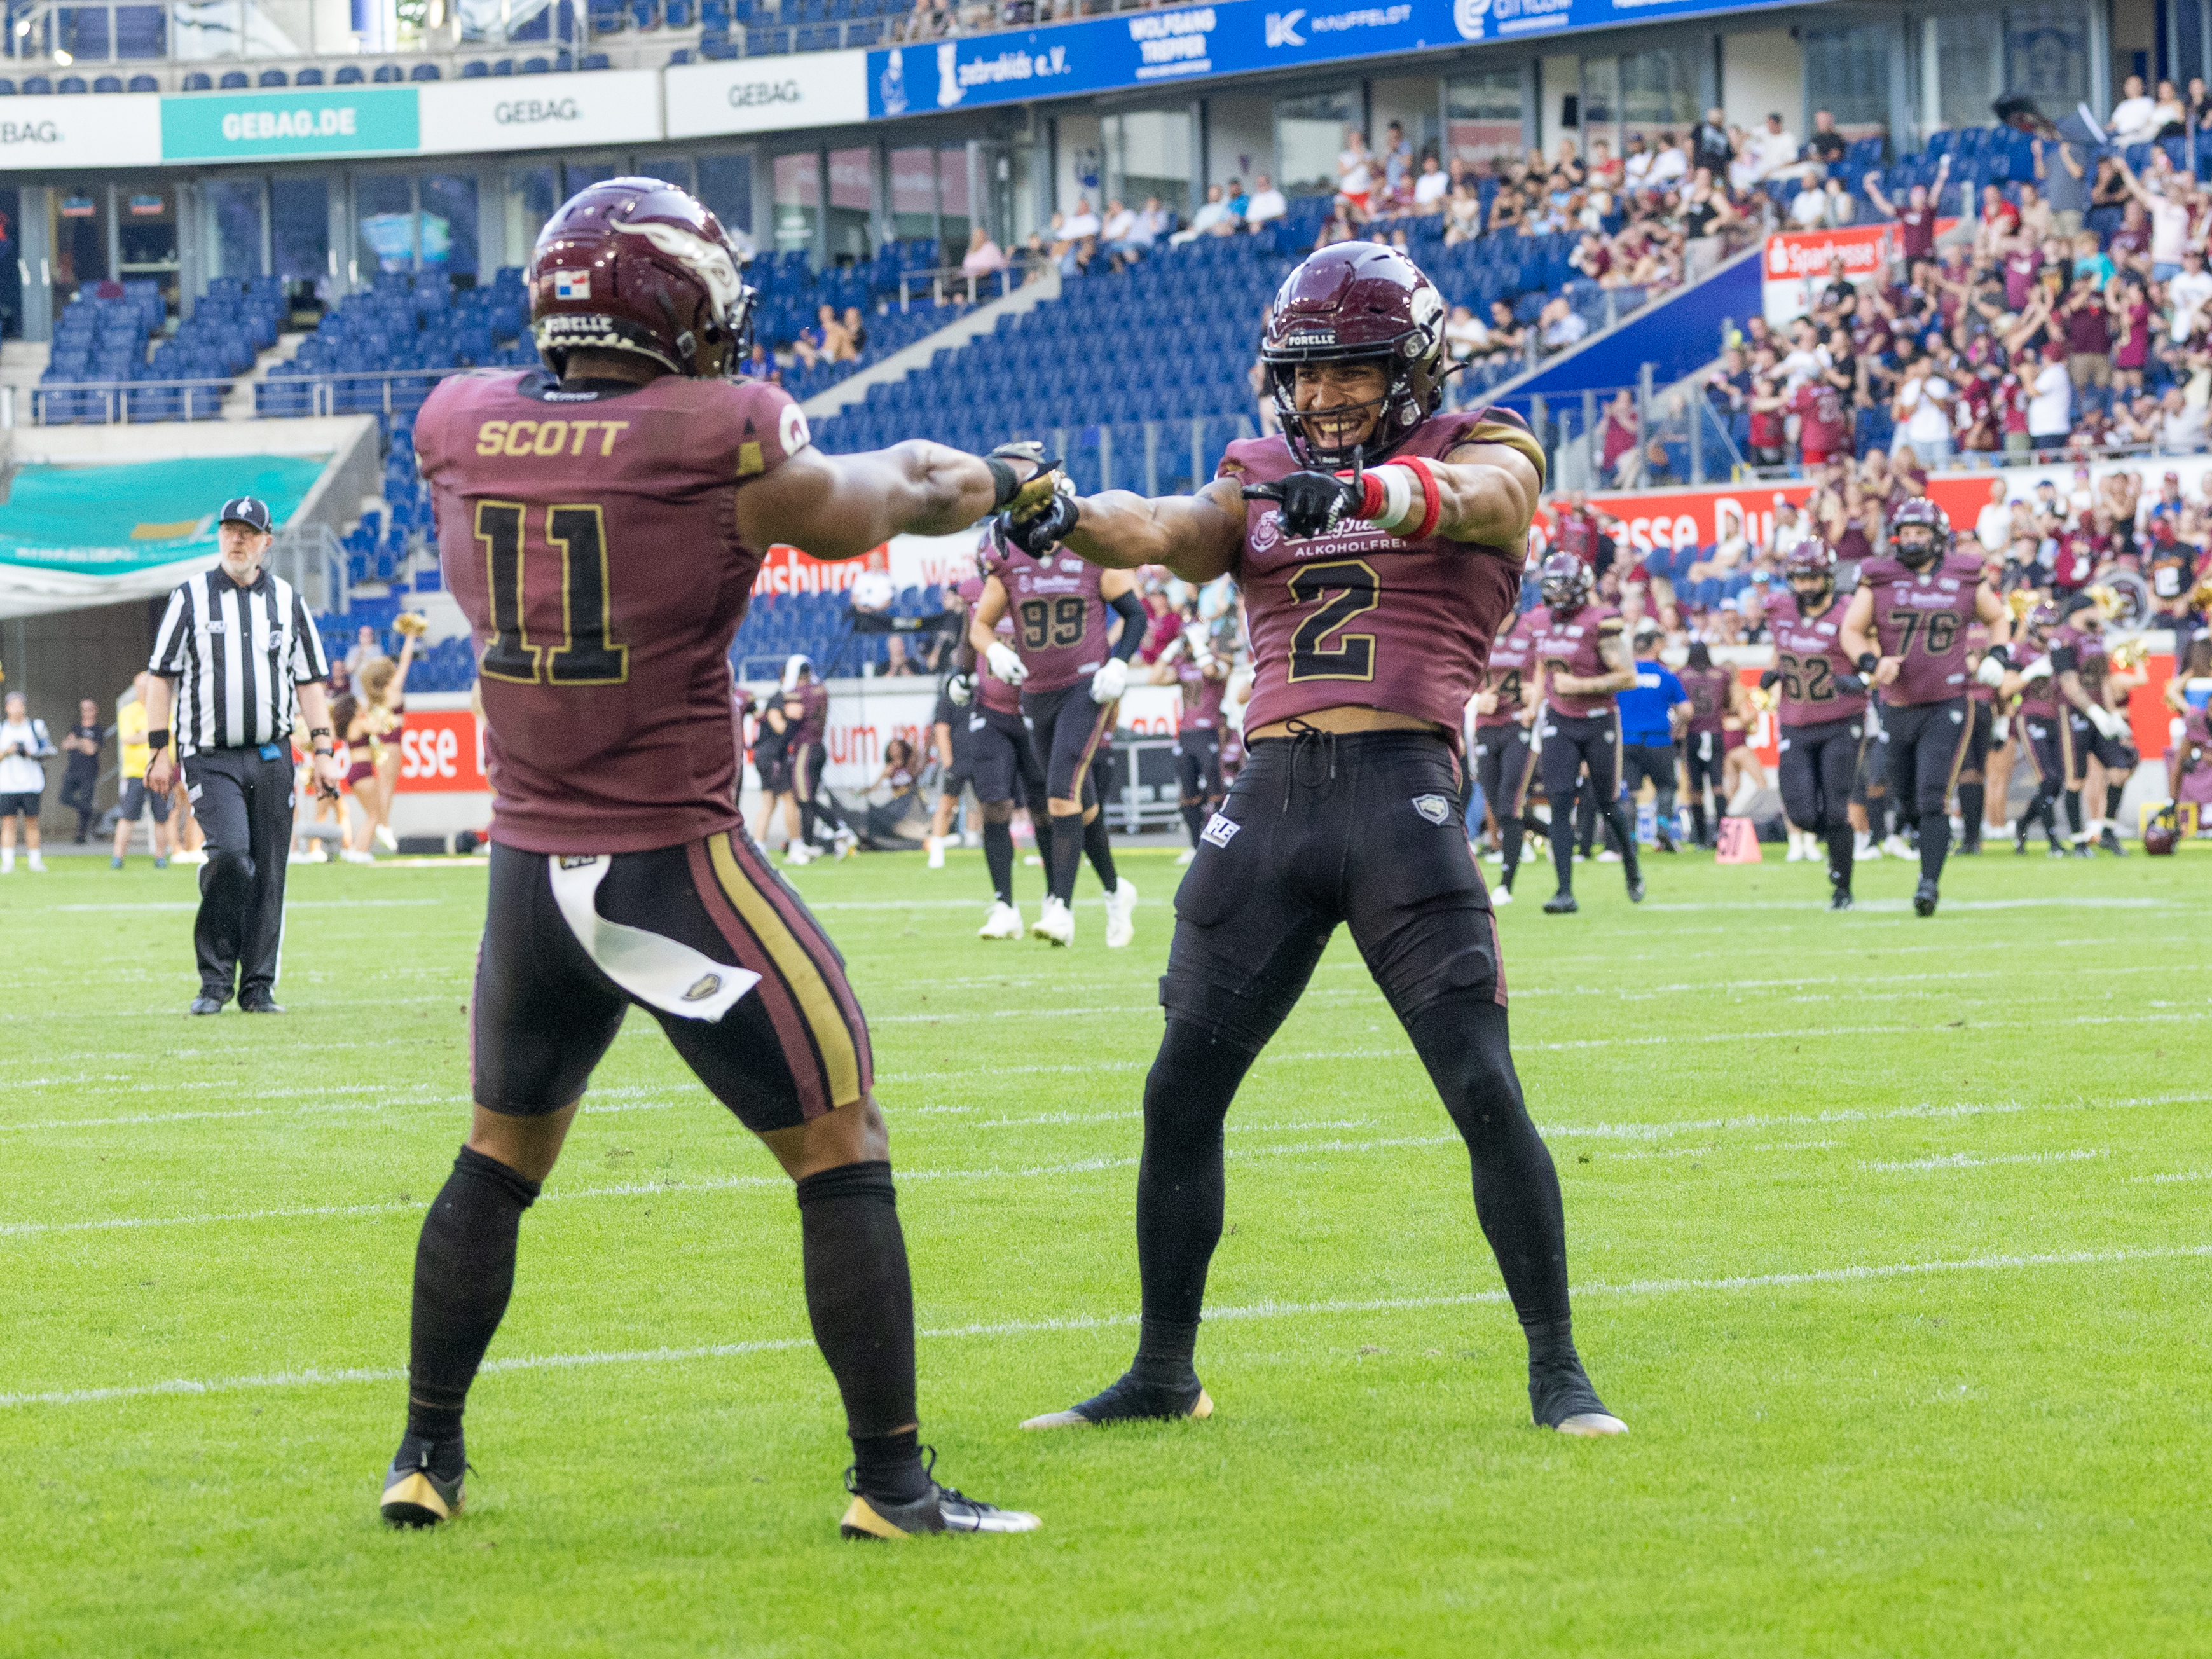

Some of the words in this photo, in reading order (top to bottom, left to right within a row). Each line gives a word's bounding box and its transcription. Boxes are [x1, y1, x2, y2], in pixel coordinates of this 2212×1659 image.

[1129, 8, 1216, 41] WOLFGANG
[1034, 45, 1071, 77] e.V.
[221, 107, 357, 141] GEBAG.DE
[1288, 334, 1335, 346] FORELLE
[476, 421, 629, 457] SCOTT
[474, 499, 630, 686] 11
[1020, 596, 1088, 652] 99
[1287, 559, 1380, 684] 2
[1888, 607, 1962, 657] 76
